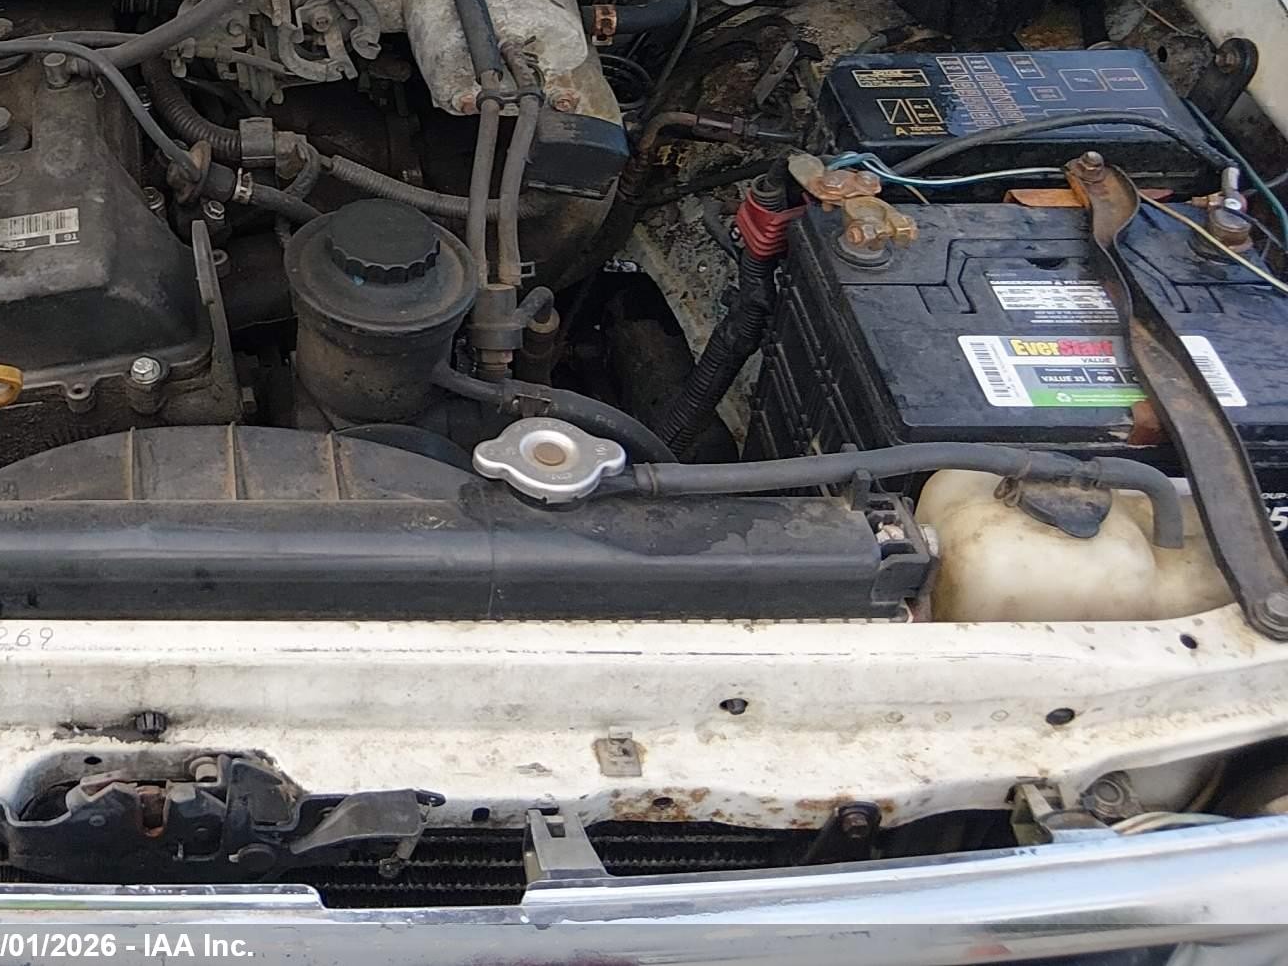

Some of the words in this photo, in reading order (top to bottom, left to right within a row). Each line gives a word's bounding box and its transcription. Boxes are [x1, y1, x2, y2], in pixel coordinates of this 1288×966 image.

[1010, 339, 1113, 357] EverStart
[1040, 375, 1071, 383] VALUE
[1261, 492, 1287, 500] OUP
